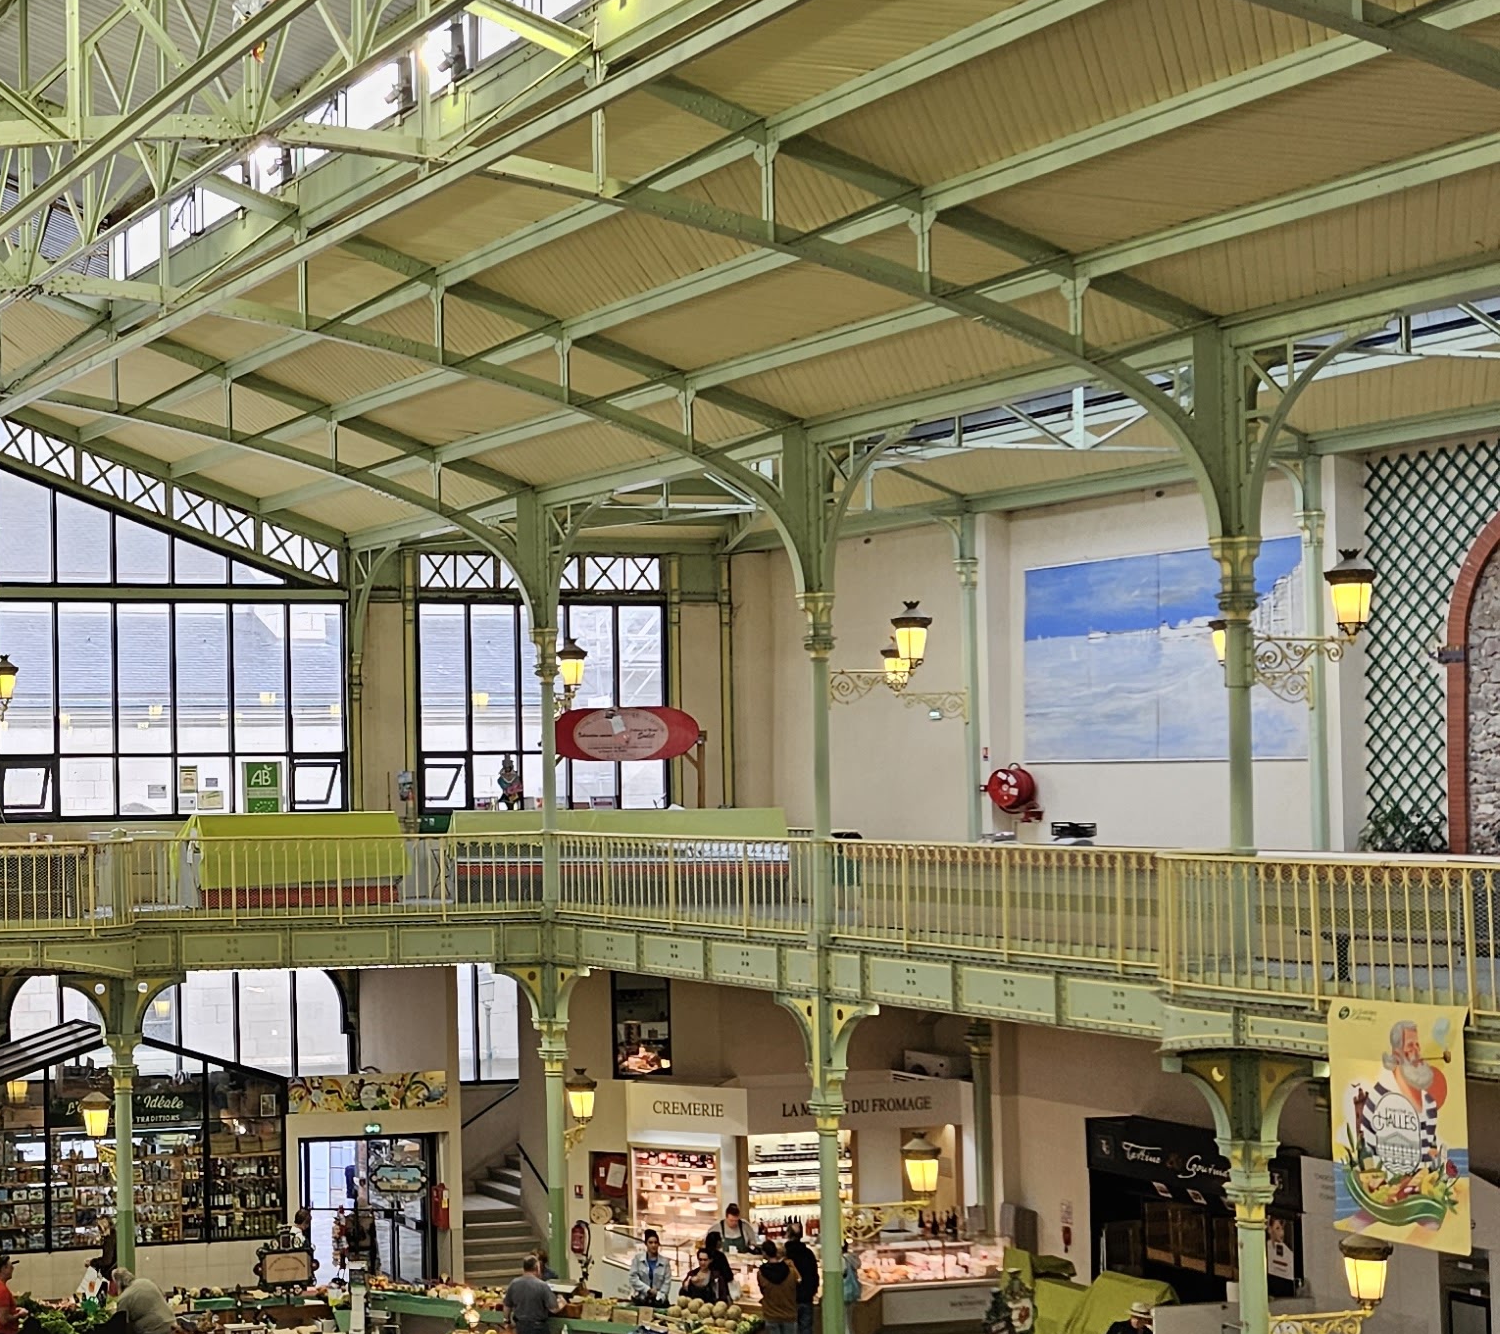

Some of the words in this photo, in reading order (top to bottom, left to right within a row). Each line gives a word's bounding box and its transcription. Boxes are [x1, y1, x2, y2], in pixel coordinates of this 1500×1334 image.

[251, 770, 271, 785] AB
[143, 1095, 185, 1109] Idéale
[653, 1100, 724, 1117] CREMERIE
[782, 1103, 798, 1117] LA
[852, 1099, 868, 1114] DU
[871, 1096, 932, 1113] FROMAGE
[136, 1114, 180, 1123] TRADITIONS
